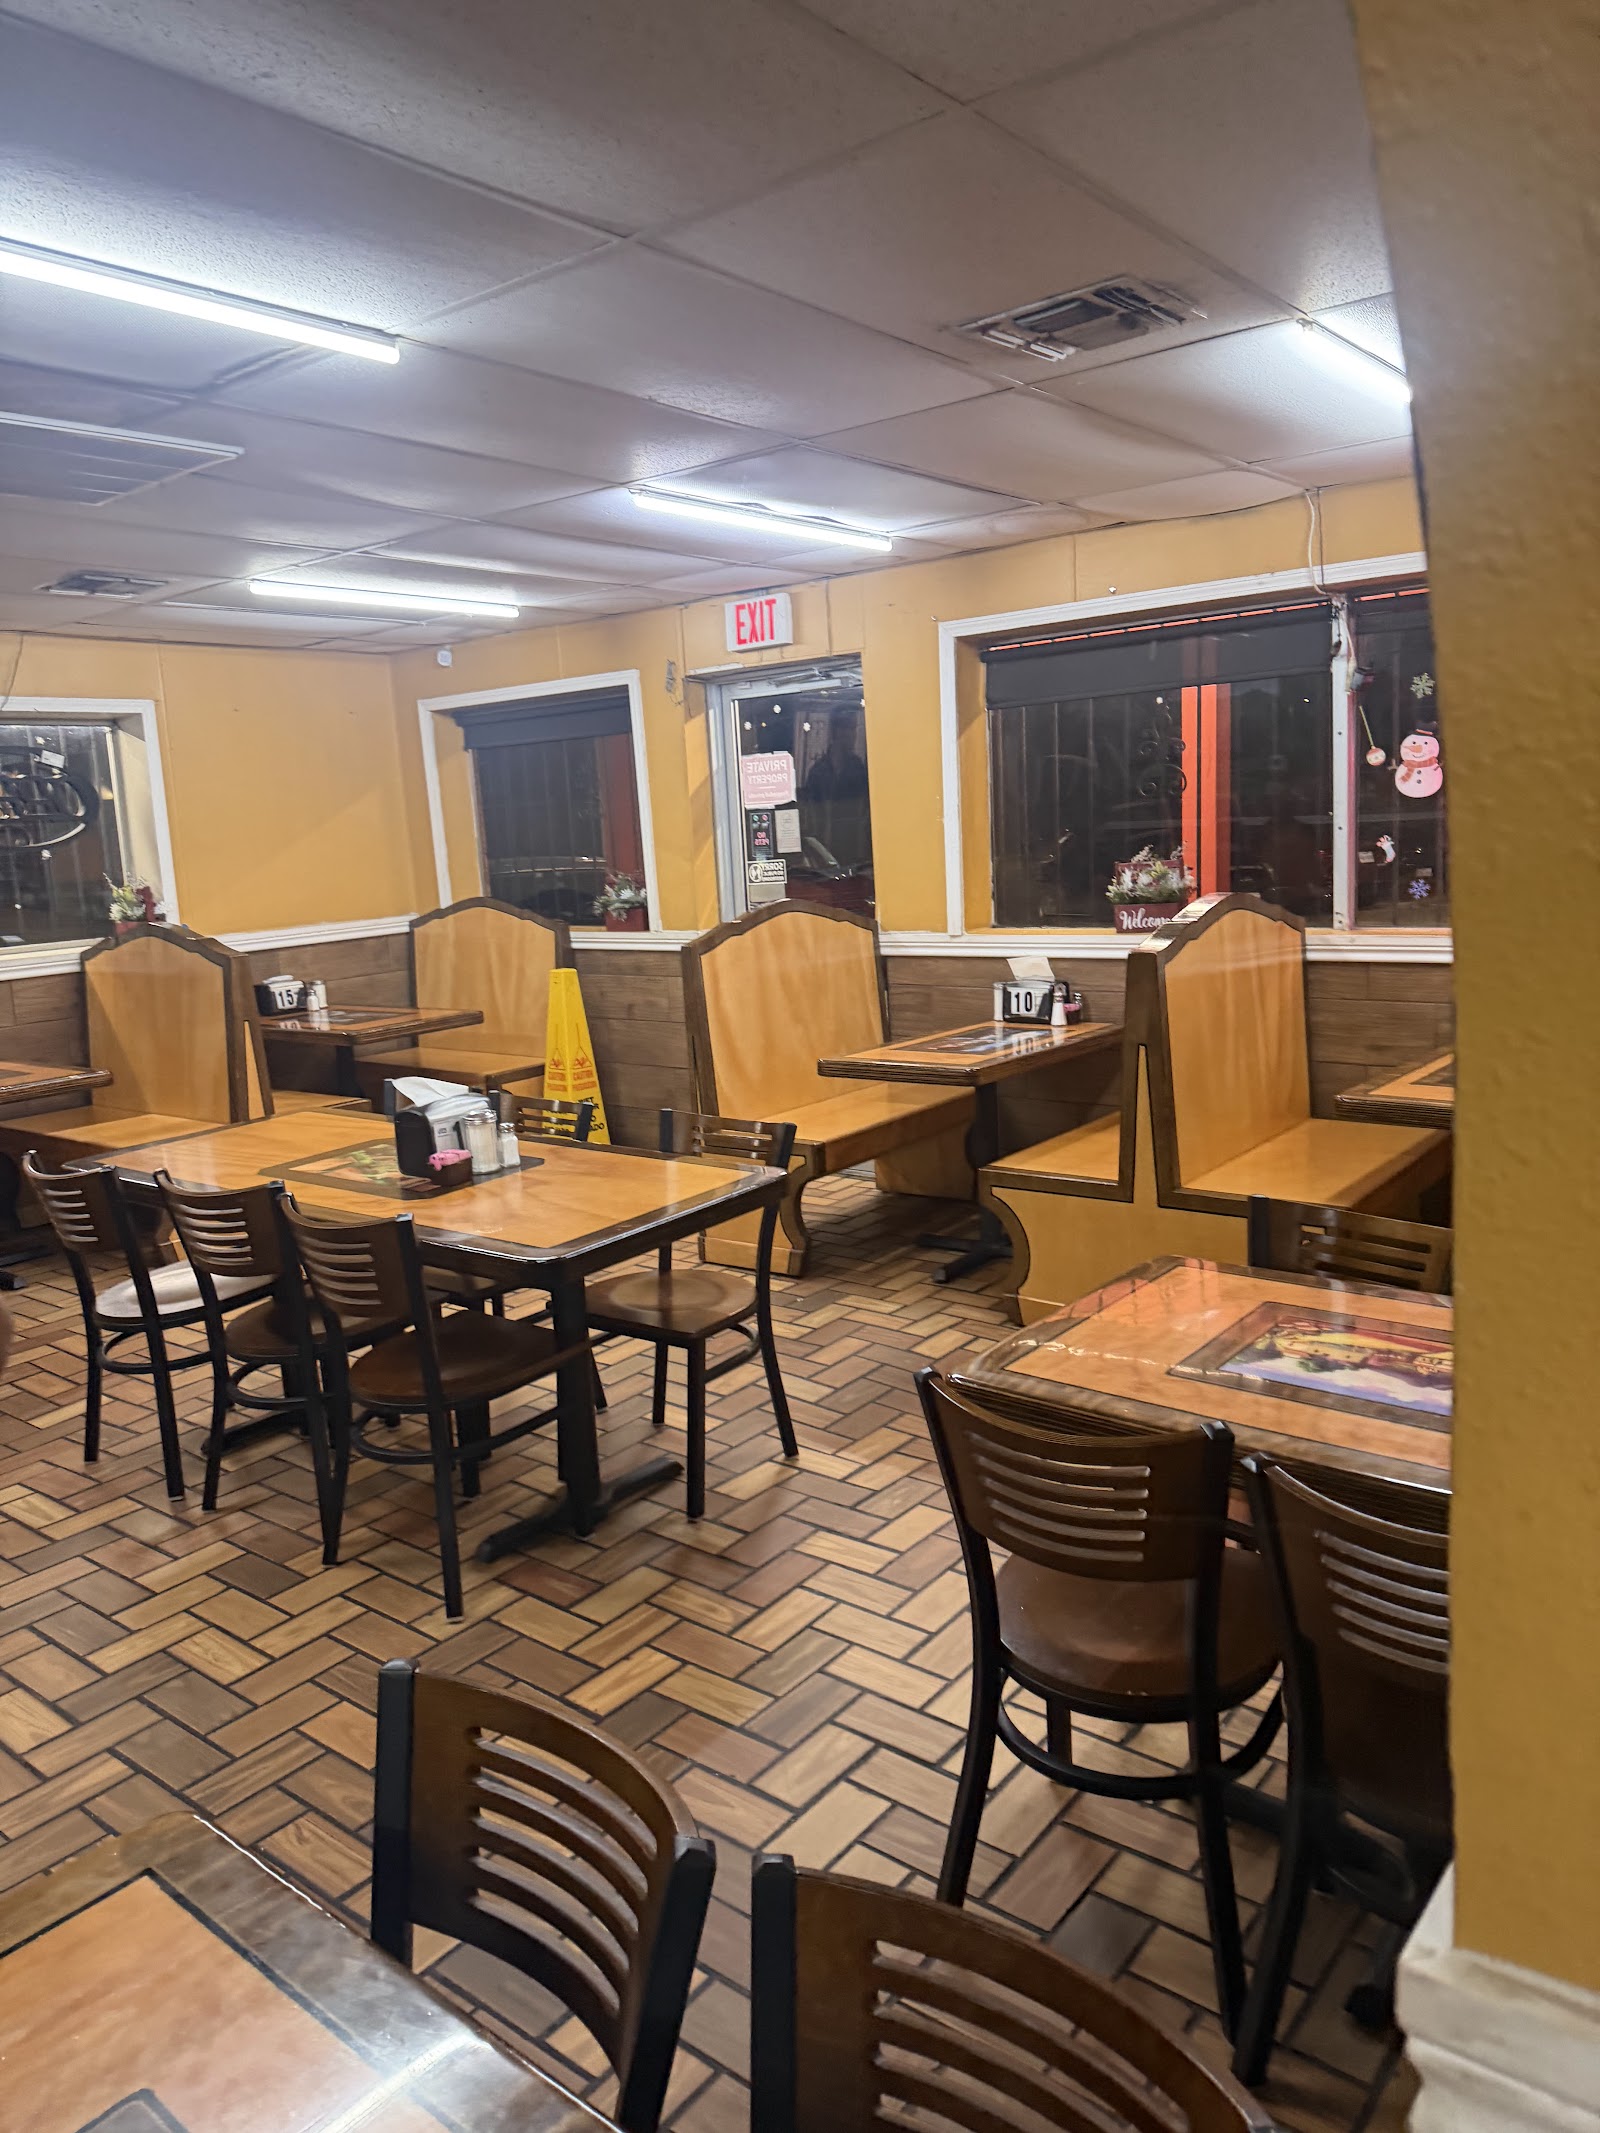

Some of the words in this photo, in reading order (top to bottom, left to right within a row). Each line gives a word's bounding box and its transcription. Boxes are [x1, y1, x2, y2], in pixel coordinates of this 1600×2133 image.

[736, 599, 776, 645] EXIT
[279, 990, 294, 1007] 15
[1014, 991, 1033, 1012] 10
